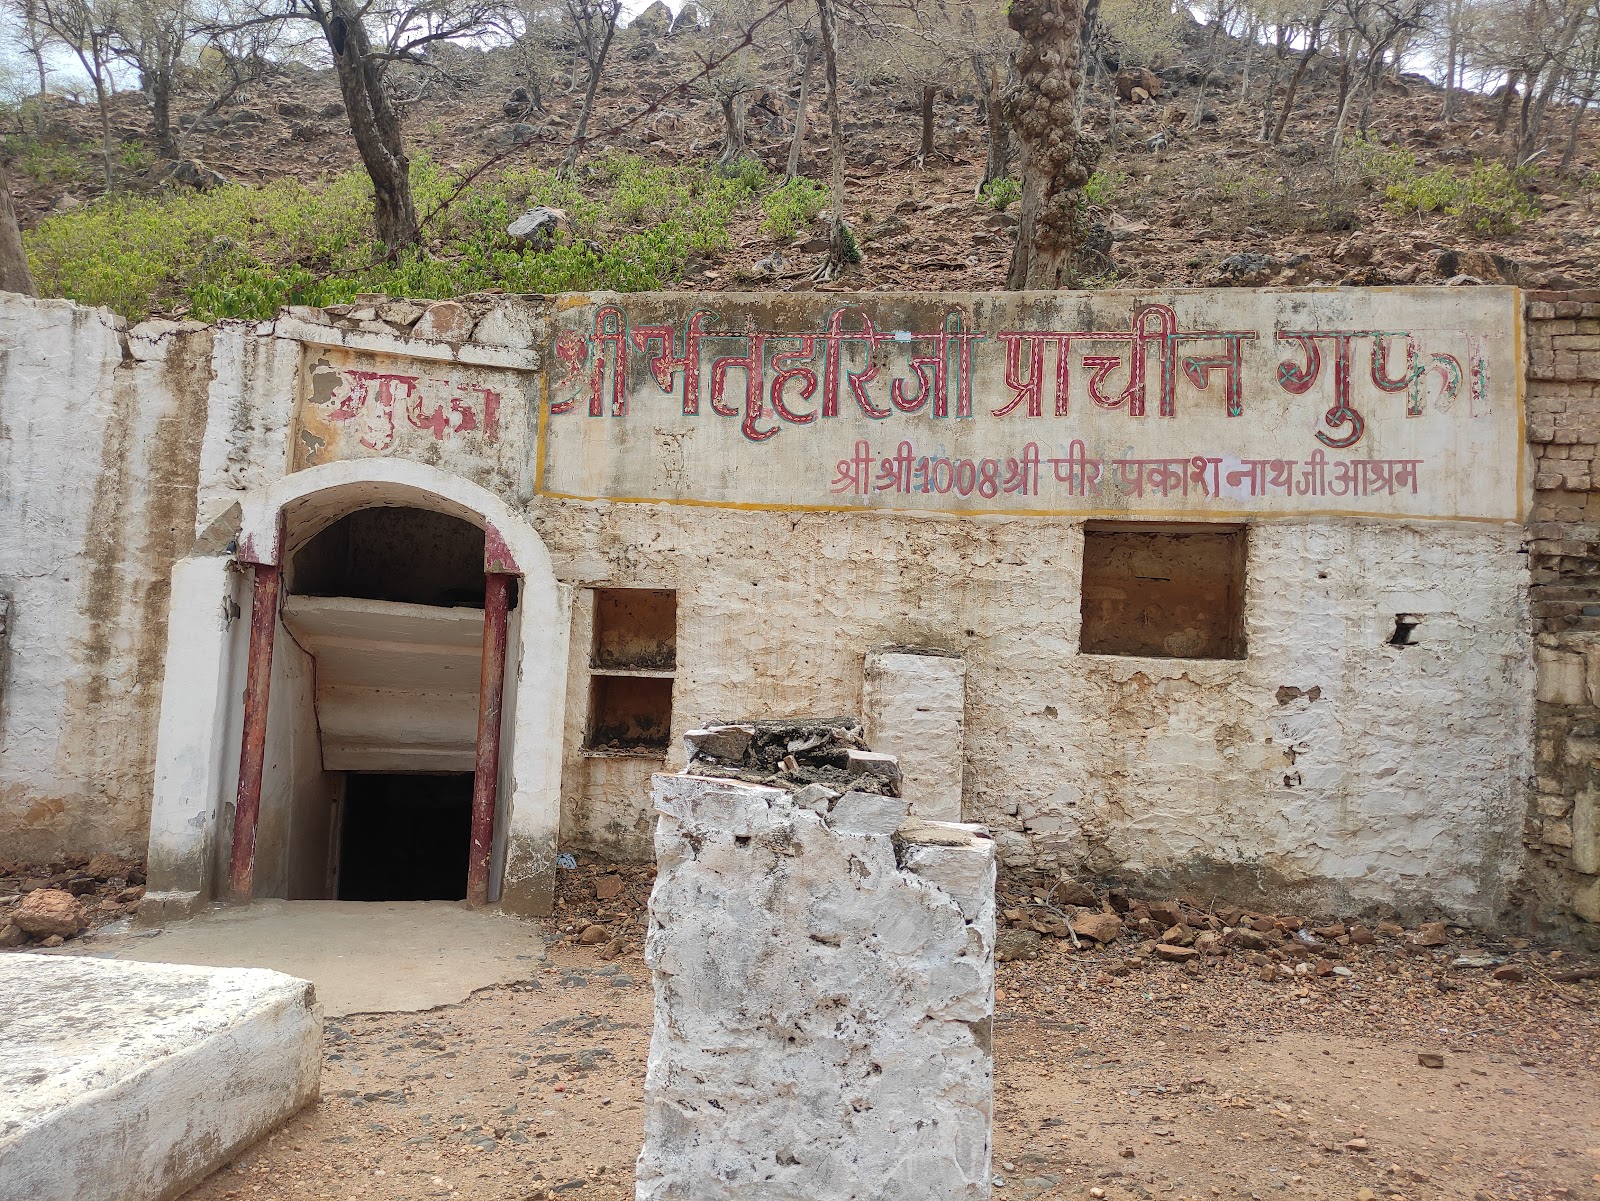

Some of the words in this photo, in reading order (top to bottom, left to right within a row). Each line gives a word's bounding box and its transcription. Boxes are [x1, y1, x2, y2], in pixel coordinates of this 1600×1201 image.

[549, 304, 628, 417] श्री
[990, 303, 1259, 419] प्राचीन
[1275, 328, 1502, 449] गुफा
[829, 439, 876, 495] श्री
[876, 440, 916, 494] श्री
[913, 457, 999, 499] 1008
[1002, 441, 1041, 496] श्री
[1046, 439, 1103, 497] पीर
[1112, 456, 1224, 498] प्रकाश
